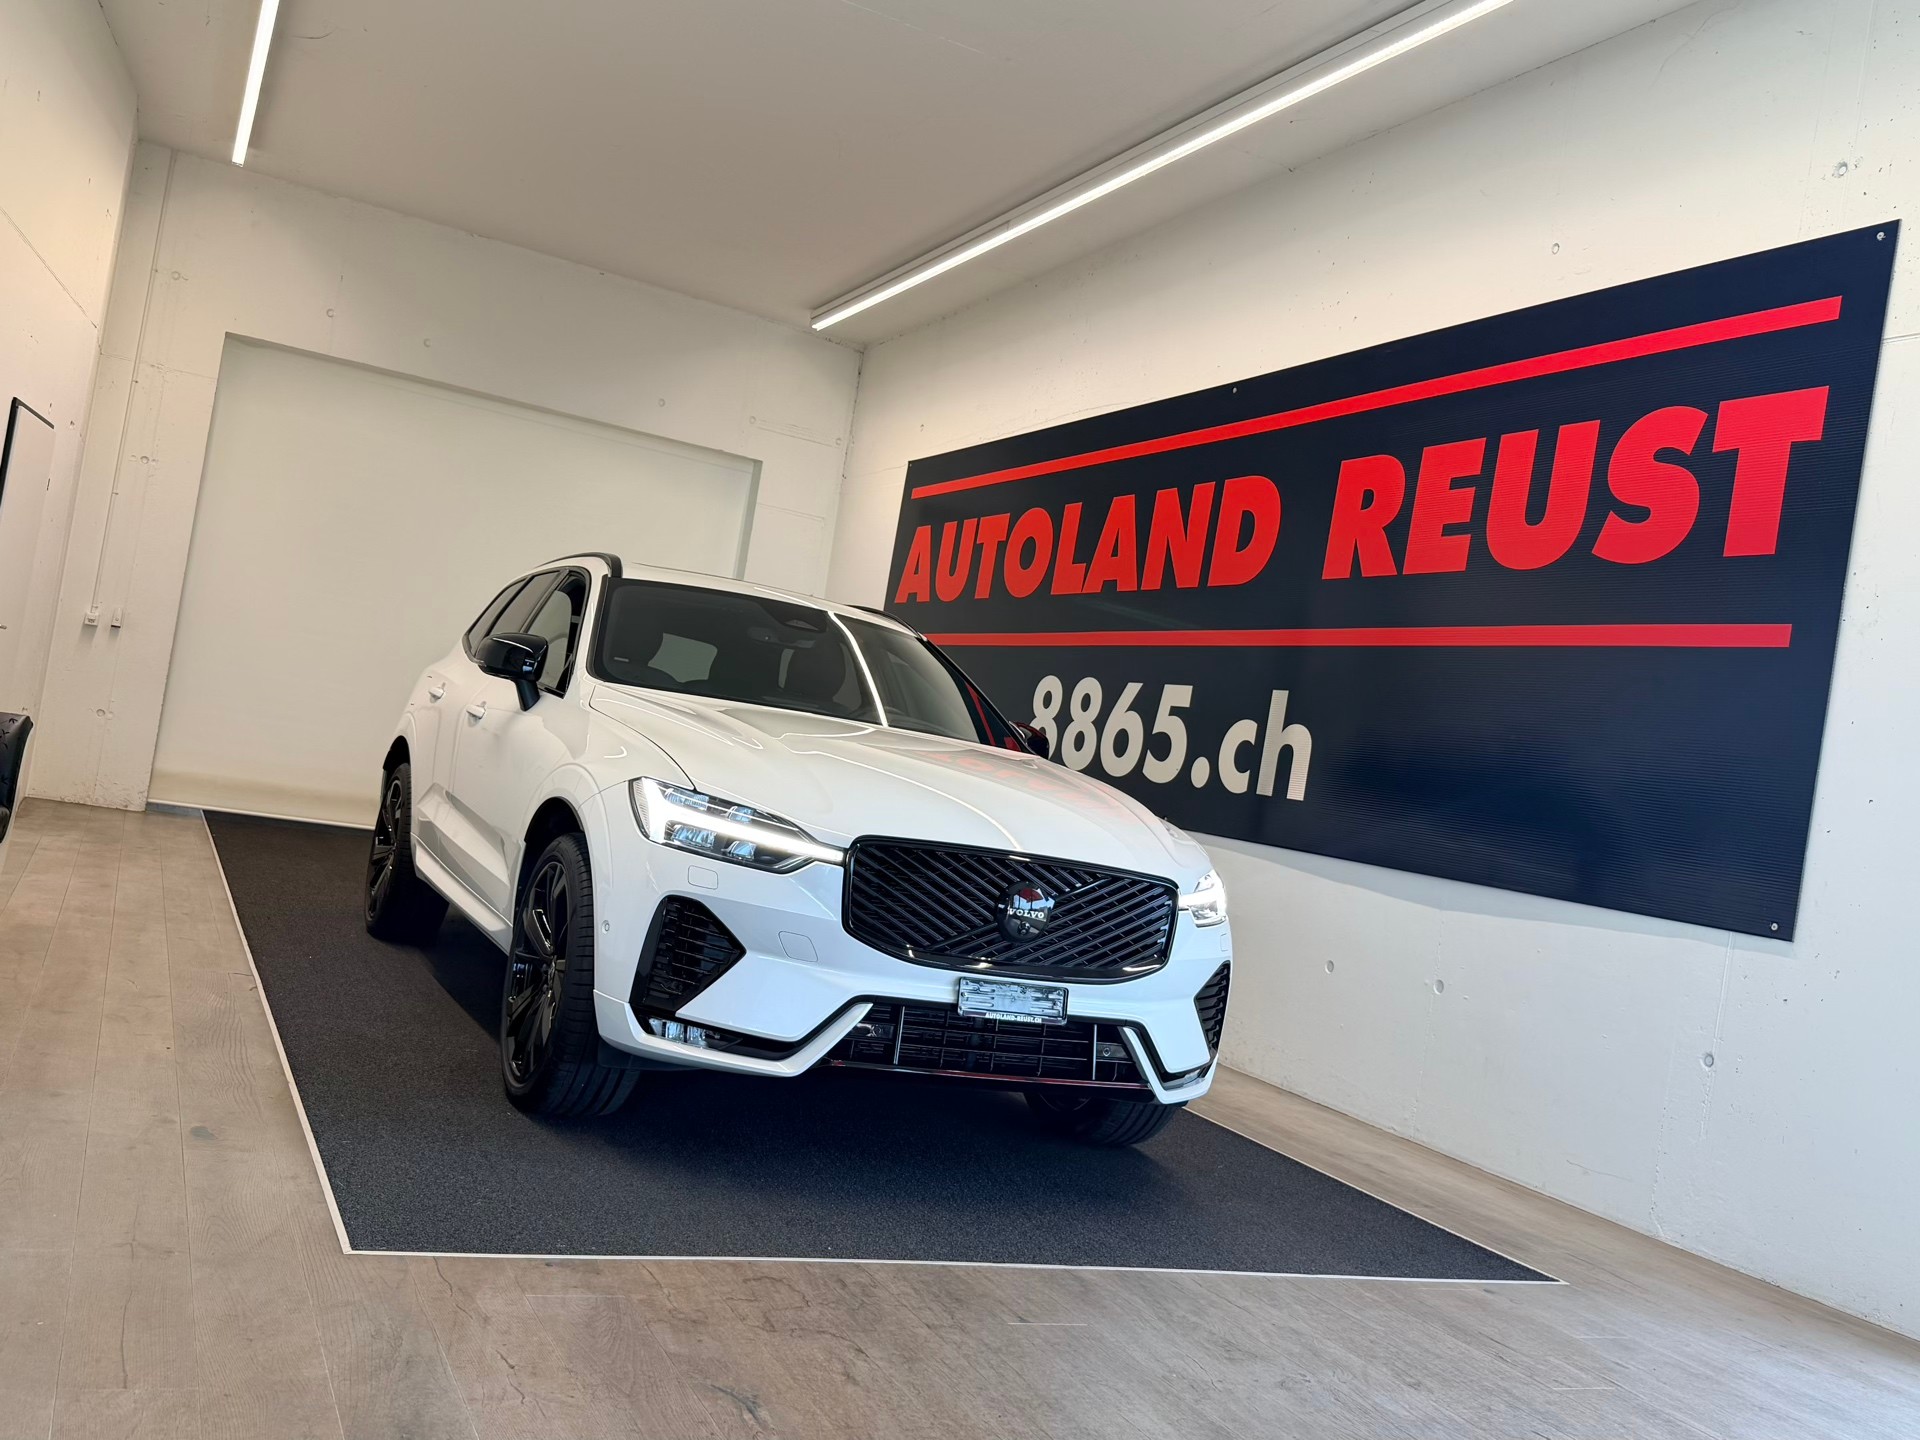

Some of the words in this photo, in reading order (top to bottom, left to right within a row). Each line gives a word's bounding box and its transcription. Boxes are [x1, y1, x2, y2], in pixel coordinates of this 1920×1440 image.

[894, 475, 1281, 603] AUTOLAND
[1322, 386, 1830, 580] REUST
[1029, 675, 1312, 801] 8865.ch
[1008, 908, 1045, 919] VOLVO
